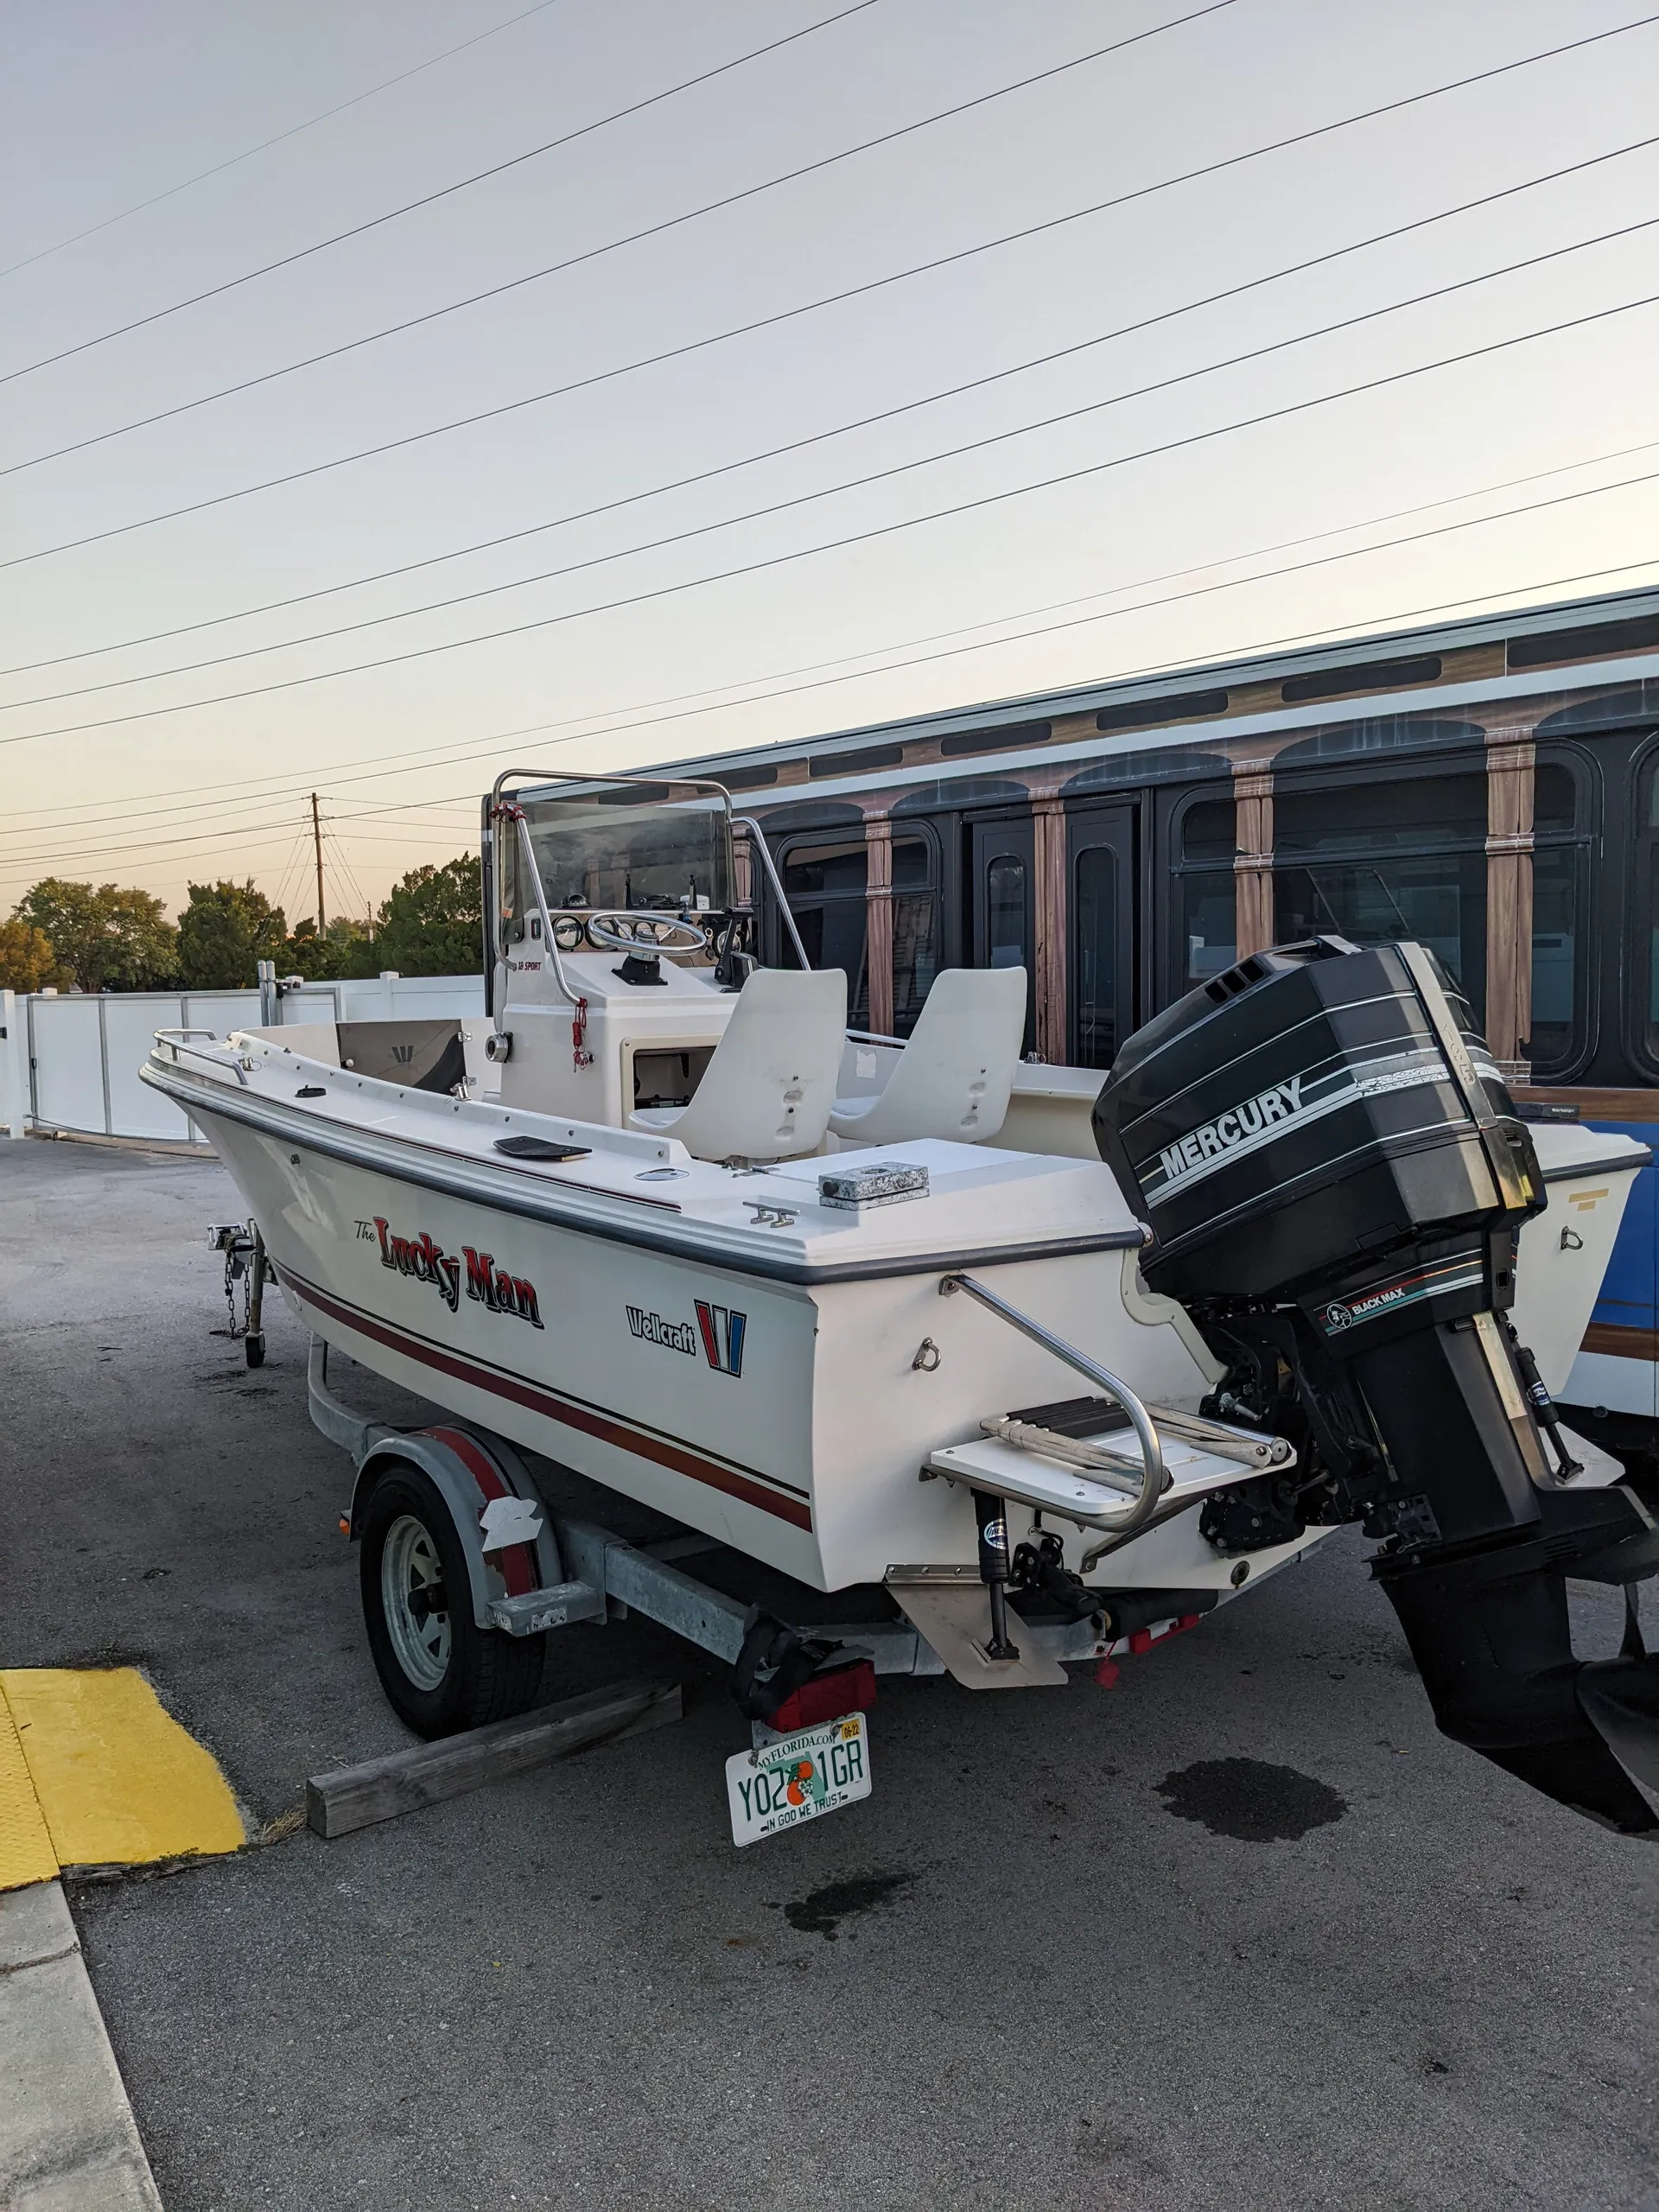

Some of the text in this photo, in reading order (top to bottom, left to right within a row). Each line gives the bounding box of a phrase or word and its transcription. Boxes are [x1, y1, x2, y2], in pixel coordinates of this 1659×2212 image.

[524, 961, 542, 971] SPORT
[1160, 1076, 1302, 1180] MERCURY
[353, 1216, 545, 1331] The Lucky Man
[1351, 1287, 1407, 1317] BLACK MAX
[625, 1304, 696, 1357] Wellcraft
[758, 1733, 836, 1770] MYFLORIDA.COM
[843, 1723, 860, 1738] 06-22
[817, 1738, 863, 1792] 1GR
[766, 1790, 842, 1833] IN GOD WE TRUST
